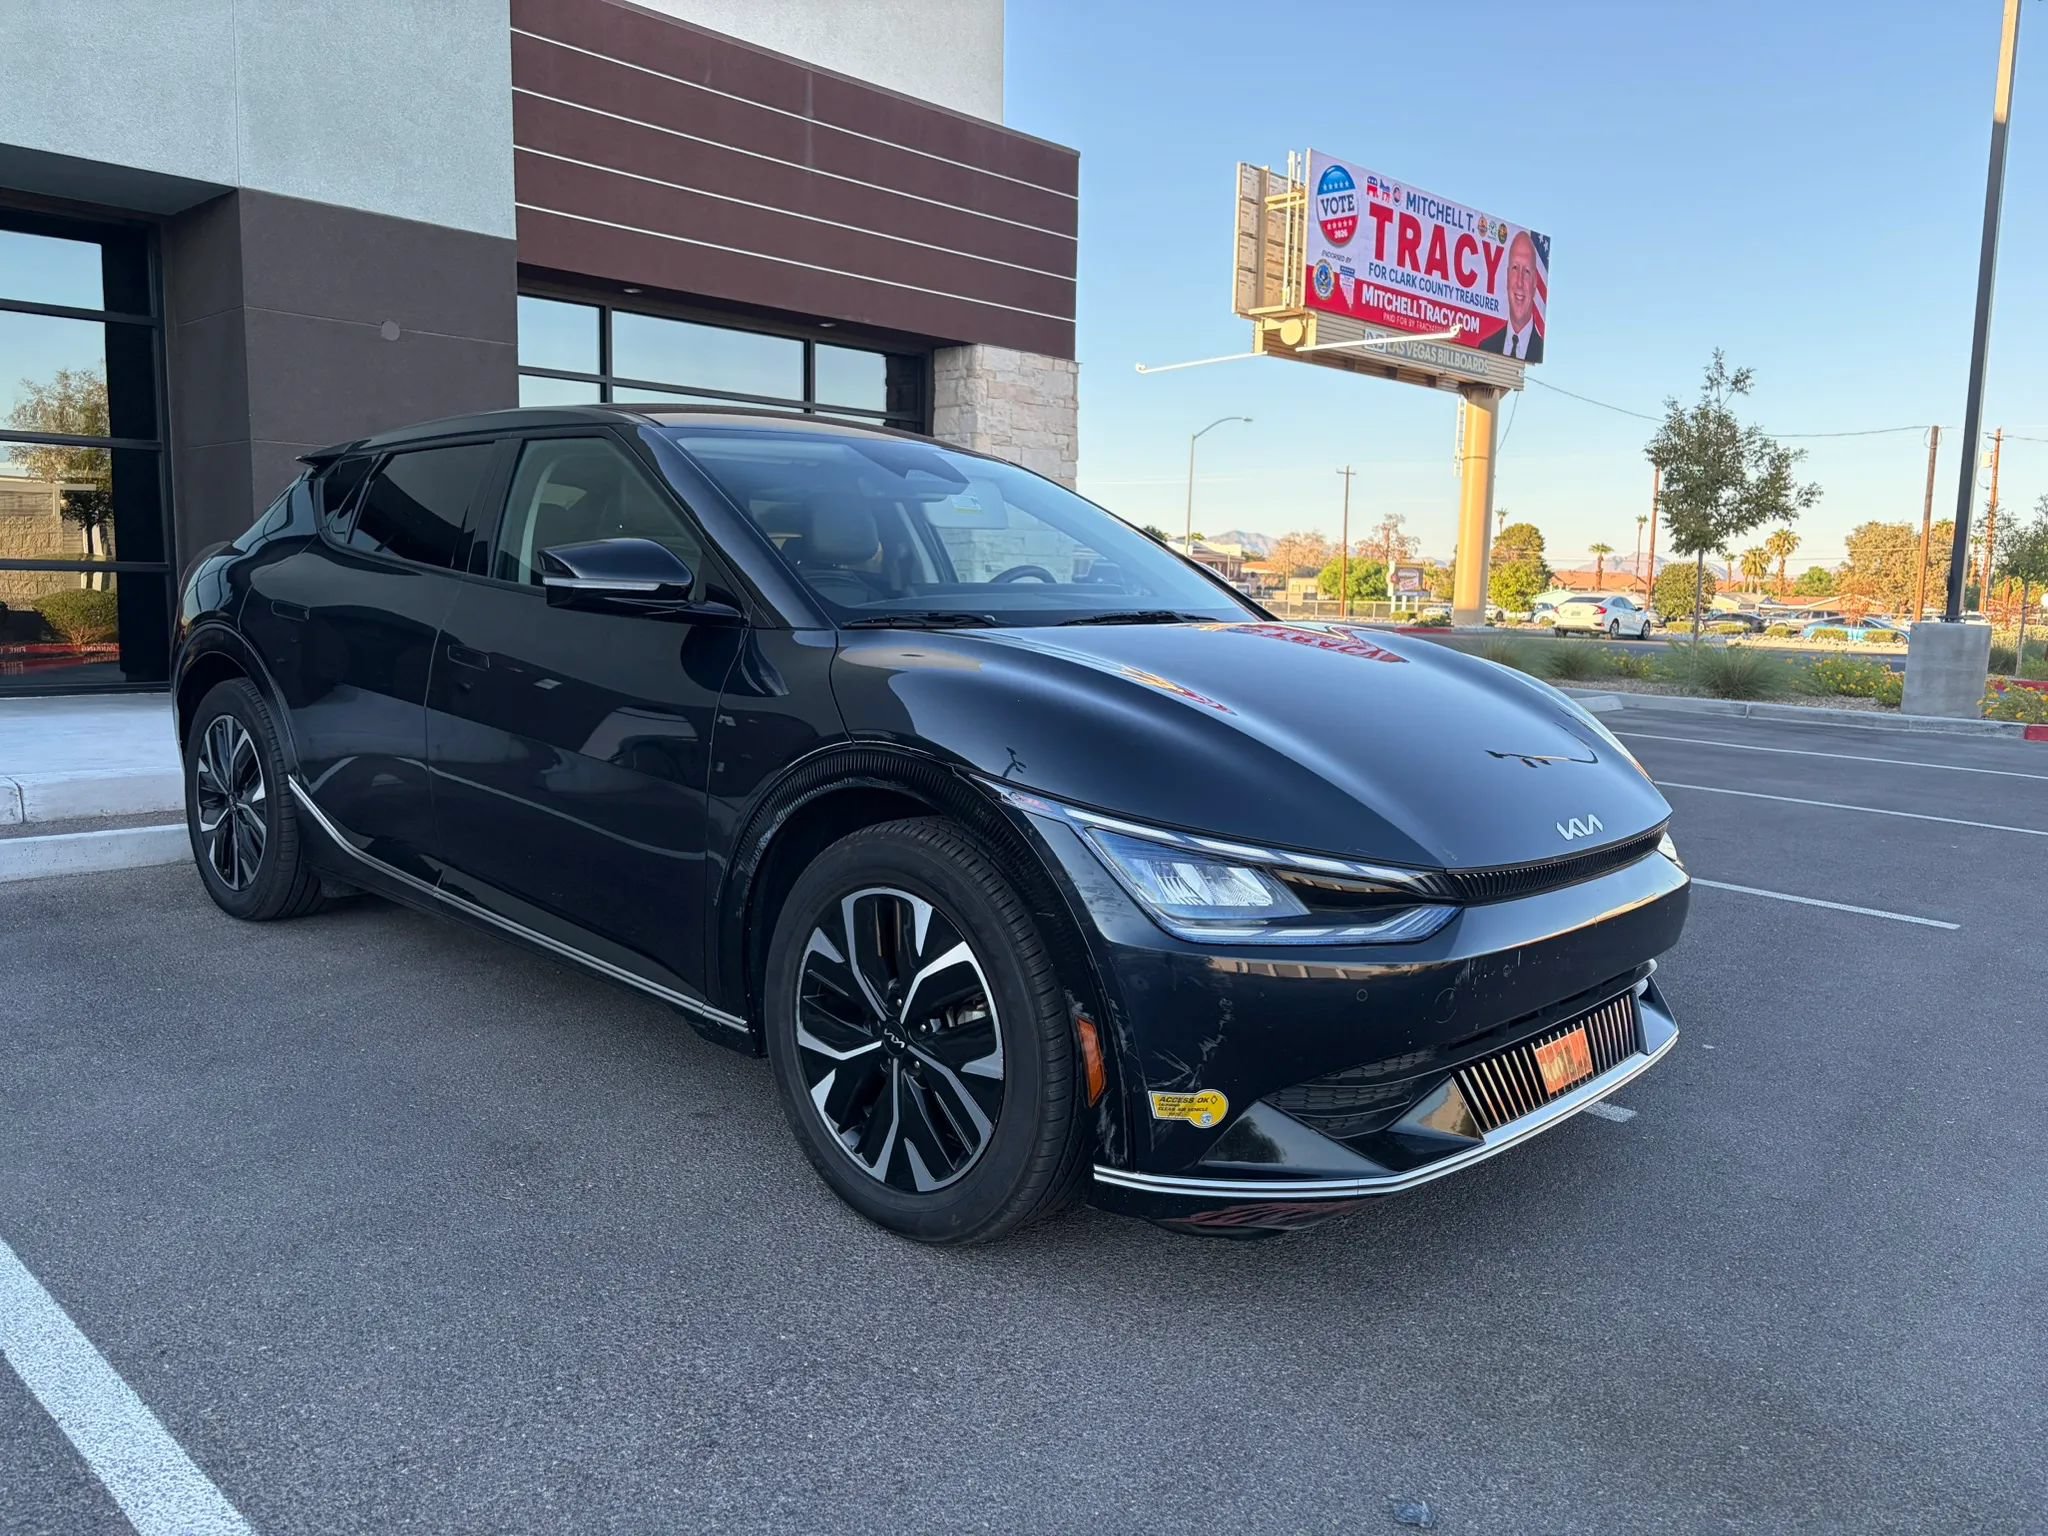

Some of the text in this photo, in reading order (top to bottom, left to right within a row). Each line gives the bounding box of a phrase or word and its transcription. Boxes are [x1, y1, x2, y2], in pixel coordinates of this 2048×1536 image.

[1320, 194, 1355, 216] VOTE
[1406, 191, 1464, 229] MITCHELL
[1466, 213, 1475, 233] T.
[1333, 228, 1348, 239] 2026
[1369, 201, 1505, 295] TRACY
[1368, 262, 1387, 280] FOR
[1389, 268, 1417, 289] CLARK
[1419, 277, 1454, 299] COUNTY
[1455, 287, 1500, 313] TREASURER
[1396, 316, 1408, 326] FOR
[1387, 340, 1406, 354] LAS
[1406, 341, 1437, 363] VEGAS
[1437, 350, 1489, 373] BILLBOARDS
[1556, 814, 1603, 840] KIA
[1159, 1096, 1194, 1104] ACCESS
